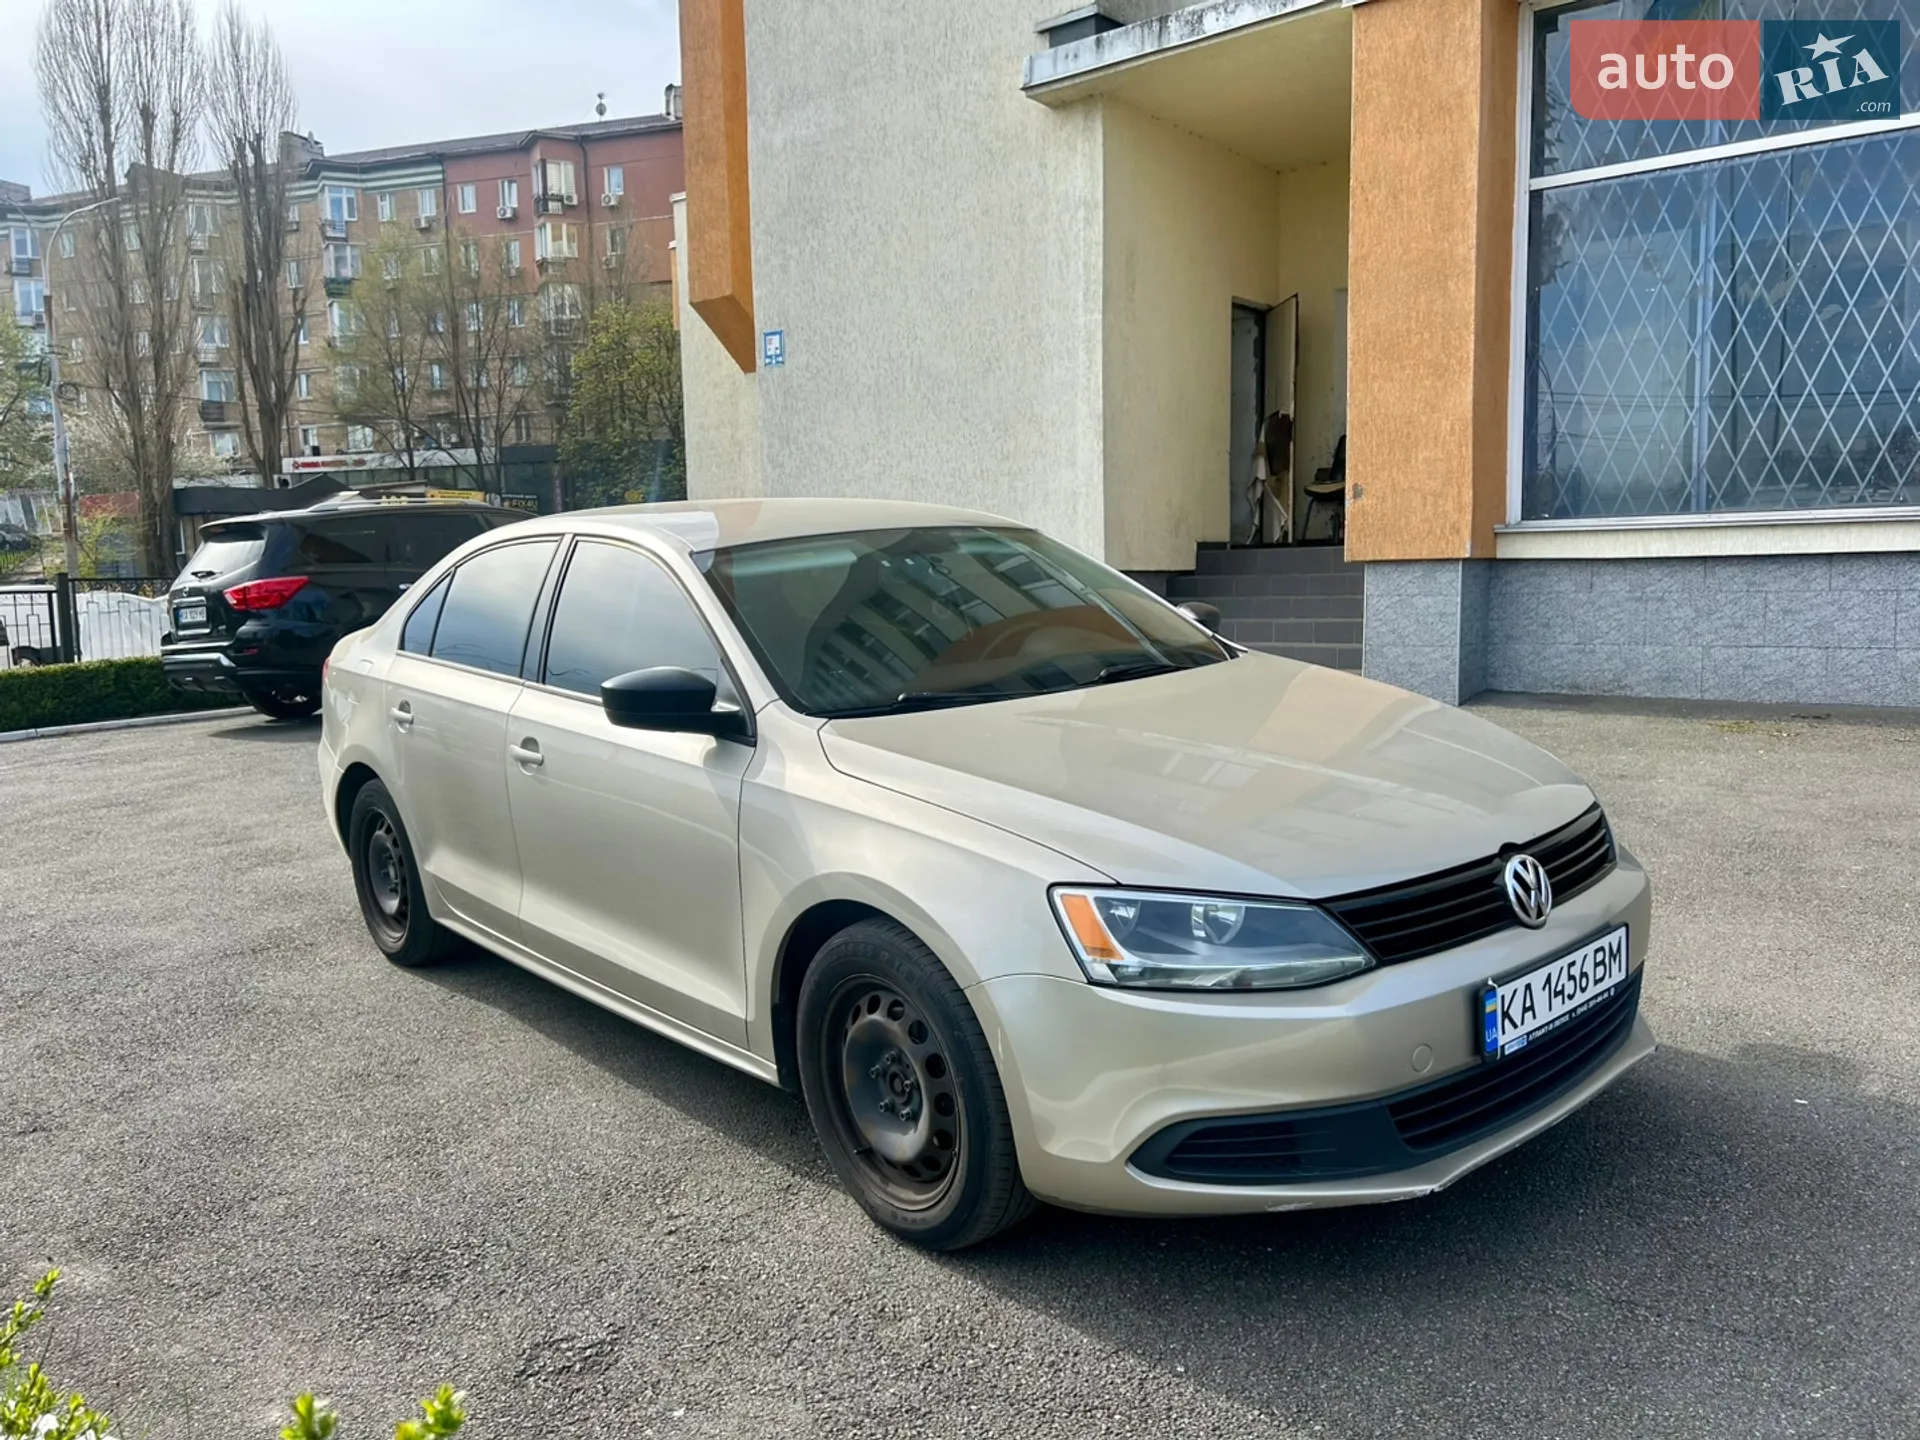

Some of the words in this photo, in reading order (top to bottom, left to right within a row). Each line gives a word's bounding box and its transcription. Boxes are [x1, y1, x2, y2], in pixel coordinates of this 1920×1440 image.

[512, 499, 538, 509] FIX4U
[1501, 982, 1537, 1035] KA
[1542, 954, 1590, 1012] 1456
[1593, 936, 1622, 986] BM
[1485, 1028, 1498, 1043] UA
